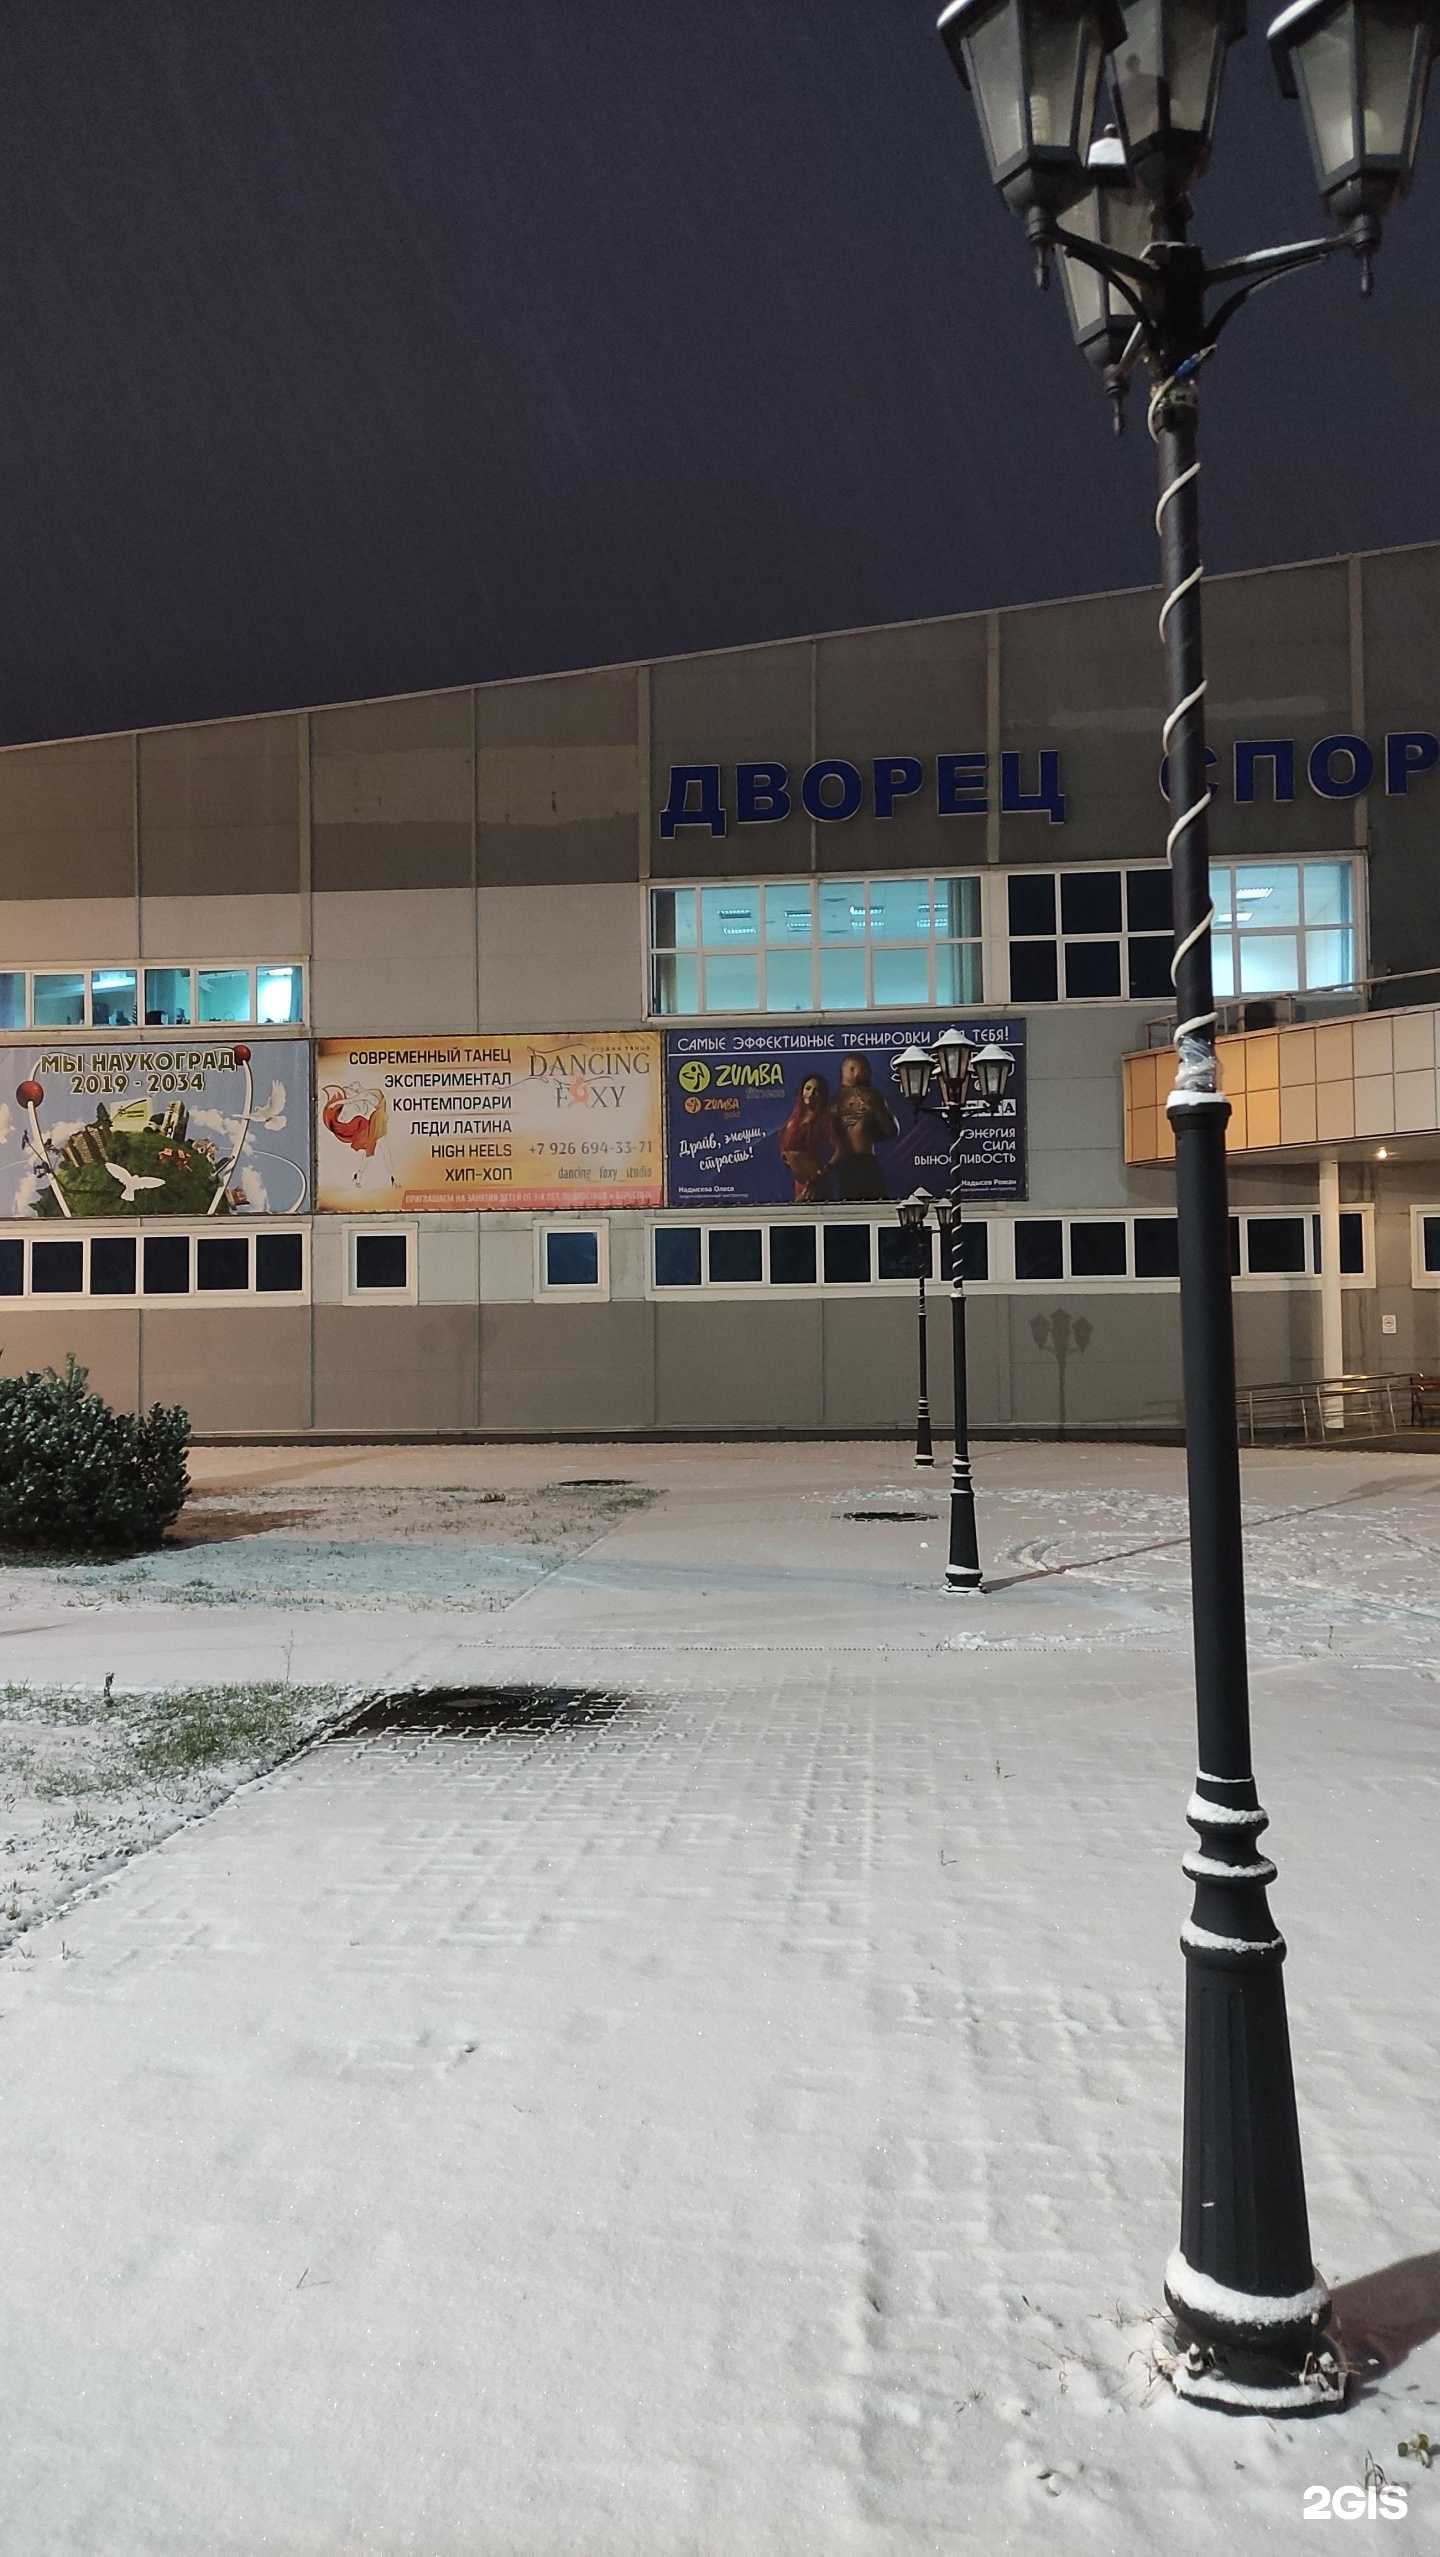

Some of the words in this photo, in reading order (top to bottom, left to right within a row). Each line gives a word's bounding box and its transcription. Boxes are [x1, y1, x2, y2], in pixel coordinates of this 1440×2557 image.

[659, 749, 1067, 839] ДВОРЕЦ
[677, 1037, 726, 1051] САМЫЕ
[732, 1034, 835, 1050] ЭФФЕКТИВНЫЕ
[841, 1031, 930, 1047] ТРЕНИРОВКИ
[973, 1025, 1009, 1042] ТЕБЯ!
[41, 1055, 83, 1073] МЫ
[92, 1050, 237, 1072] НАУКОГРАД
[349, 1047, 461, 1065] СОВРЕМЕННЫЙ
[465, 1048, 512, 1064] ТАНЕЦ
[528, 1051, 651, 1077] DANCING
[71, 1075, 126, 1093] 2019
[149, 1073, 204, 1092] 2034
[384, 1072, 512, 1088] ЭКСПЕРИМЕНТАЛ
[714, 1063, 784, 1087] ZUMBA
[393, 1096, 512, 1112] КОНТЕМПОРАРИ
[704, 1097, 740, 1111] ZUMBA
[410, 1121, 450, 1137] ЛЕДИ
[453, 1119, 513, 1134] ЛАТИНА
[964, 1128, 1016, 1139] ЭНЕРГИЯ
[431, 1145, 465, 1158] HIGH
[469, 1144, 513, 1157] HEELS
[529, 1143, 545, 1155] +7
[550, 1142, 576, 1155] 926
[581, 1140, 653, 1154] 694-33-71
[982, 1140, 1016, 1151] СИЛА
[699, 1146, 754, 1173] страсть!
[914, 1152, 1016, 1166] ВЫНОЛИВОСТЬ
[445, 1168, 513, 1182] ХИП-ХОП
